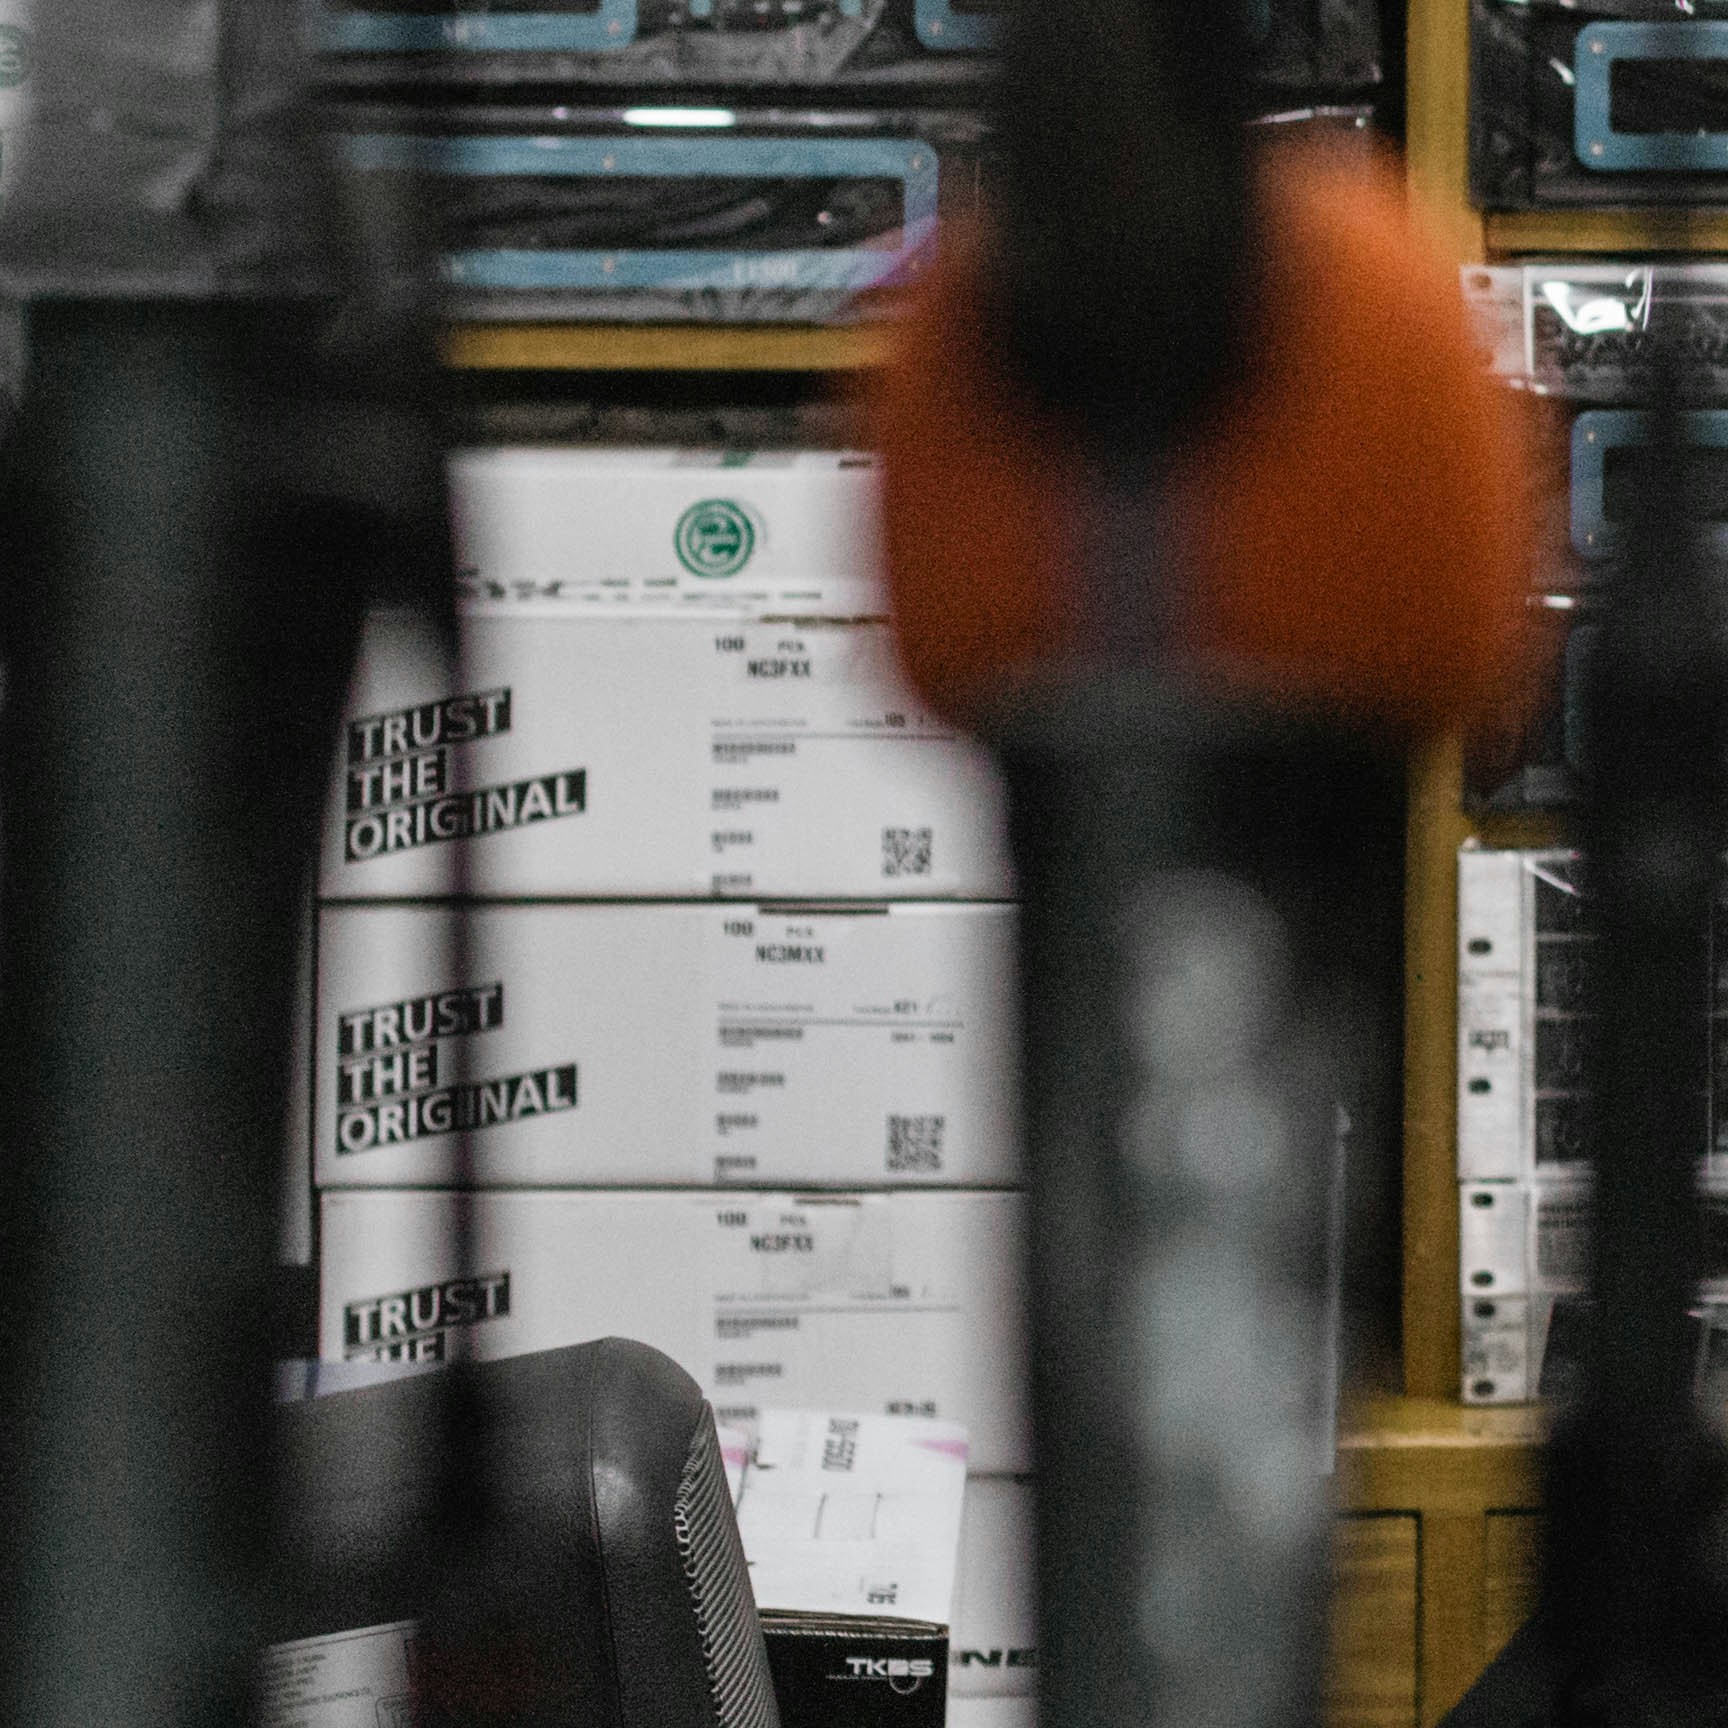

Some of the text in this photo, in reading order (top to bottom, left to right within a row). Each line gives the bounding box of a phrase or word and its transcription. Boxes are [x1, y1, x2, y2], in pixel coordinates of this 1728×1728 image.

[716, 636, 745, 652] 100
[356, 693, 507, 761] TRUST
[352, 753, 440, 807] THE
[349, 771, 582, 863] ORIGINAL
[724, 921, 754, 936] 100
[755, 945, 825, 963] NC3MXX
[346, 986, 500, 1051] TRUST
[346, 1049, 434, 1104] THE
[340, 1071, 573, 1154] ORIGINAL
[717, 1211, 747, 1226] 100
[352, 1278, 506, 1344] TRUST
